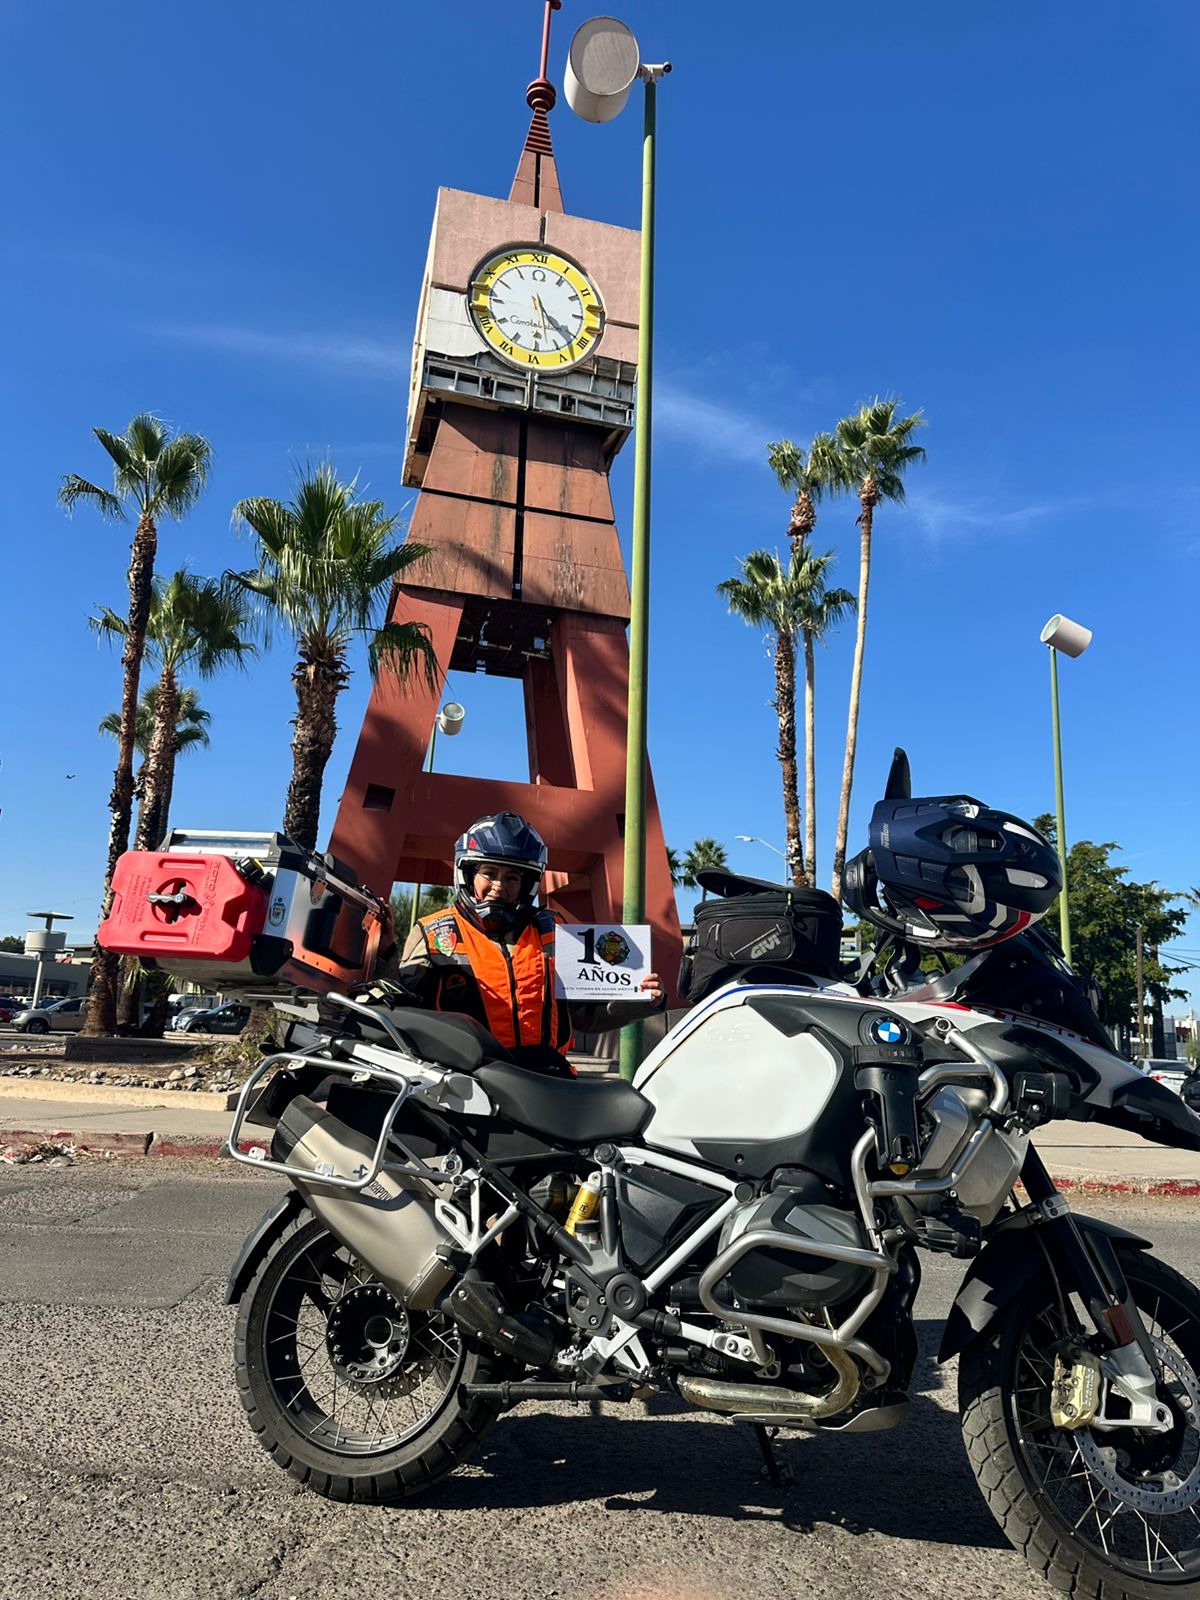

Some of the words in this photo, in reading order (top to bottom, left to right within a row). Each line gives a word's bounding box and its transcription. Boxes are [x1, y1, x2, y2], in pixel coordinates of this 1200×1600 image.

[504, 253, 519, 265] XI
[531, 253, 549, 264] XII
[563, 266, 570, 274] I
[580, 288, 591, 297] II
[499, 340, 514, 355] VII
[527, 354, 540, 365] VI
[559, 354, 568, 363] V
[750, 934, 781, 959] GIVI
[577, 965, 631, 986] AÑOS
